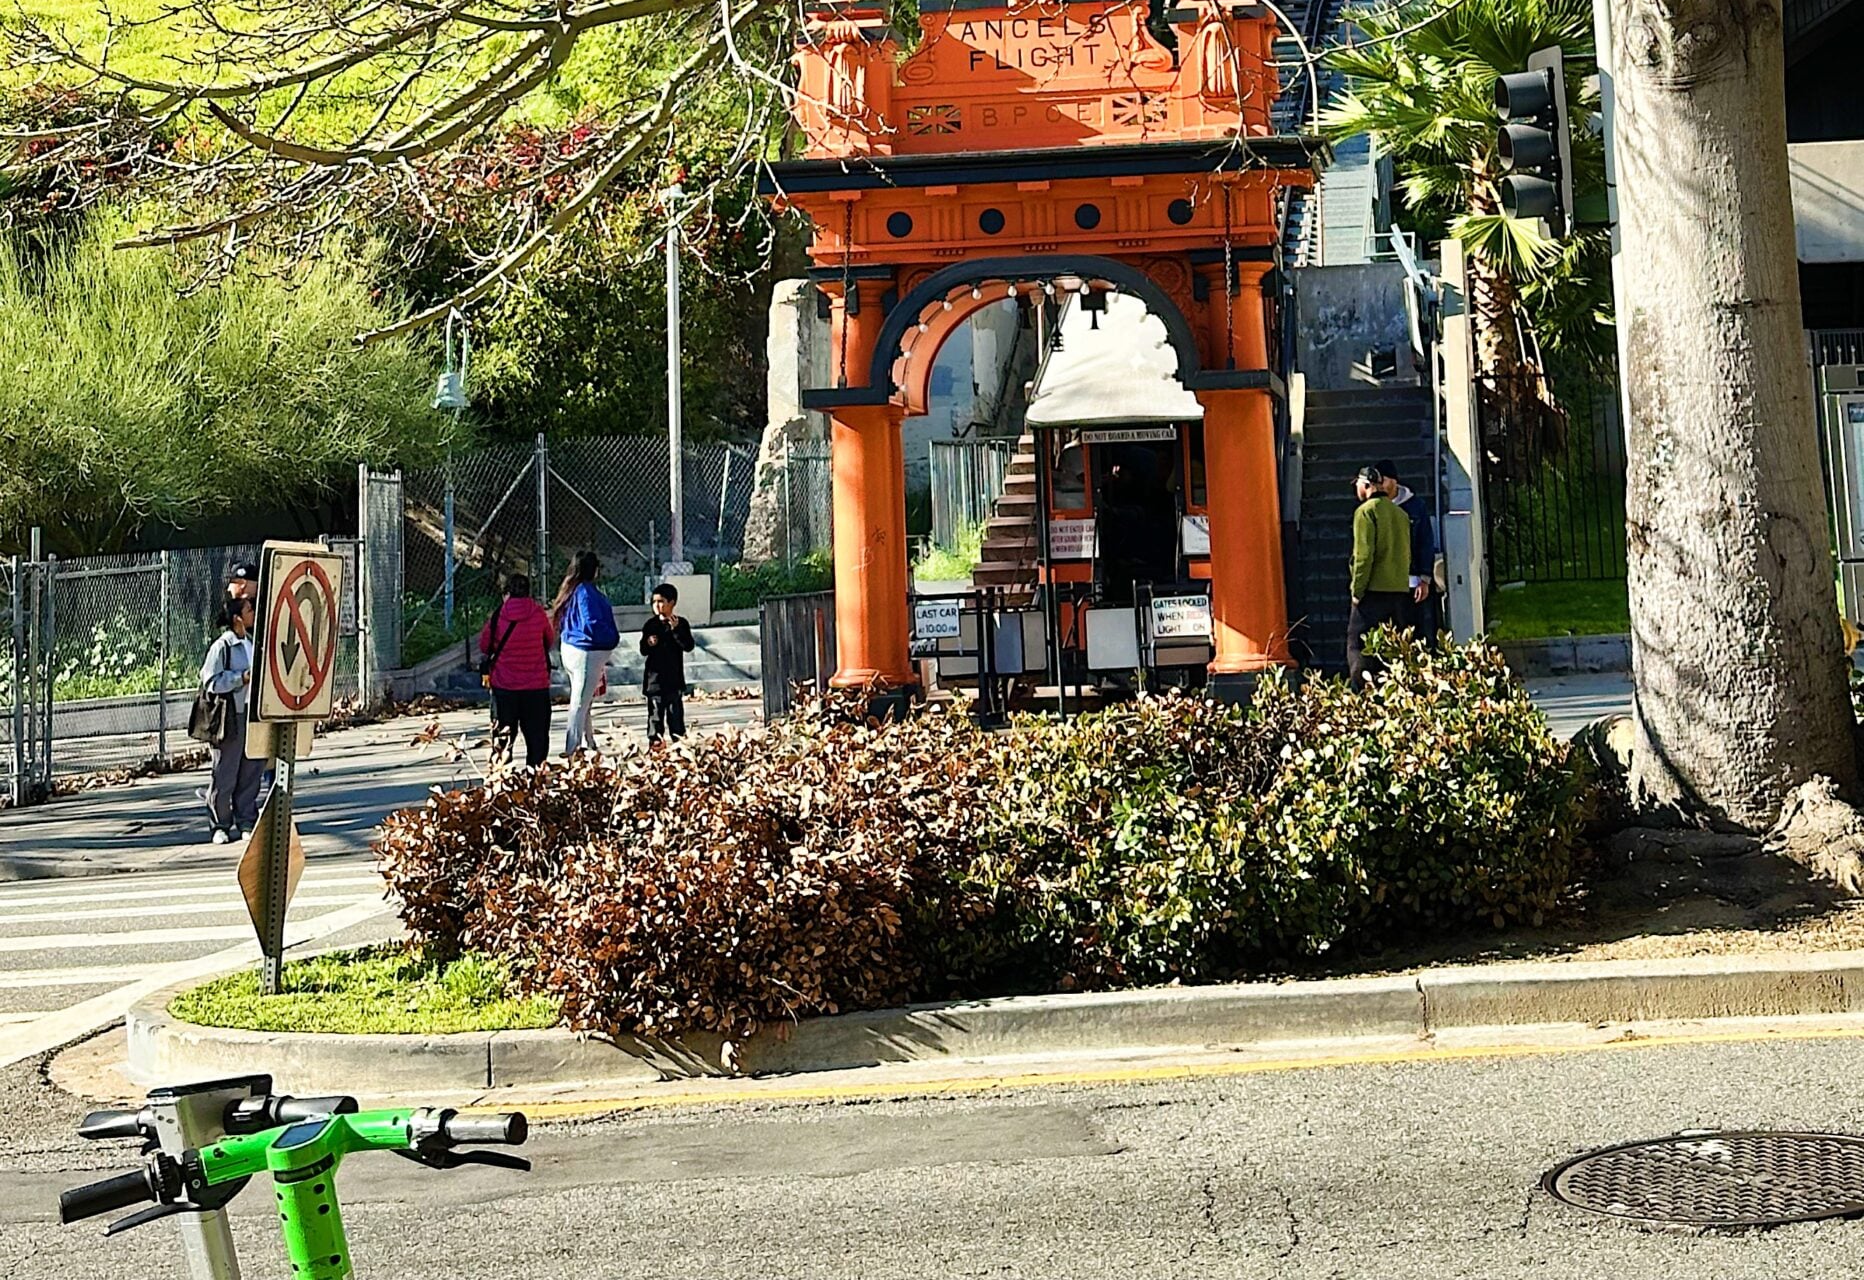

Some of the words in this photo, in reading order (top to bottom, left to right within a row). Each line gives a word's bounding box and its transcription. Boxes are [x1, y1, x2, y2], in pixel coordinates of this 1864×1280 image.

[969, 44, 1101, 72] FLIGHT
[1083, 433, 1094, 441] DO
[1095, 432, 1107, 440] NOT
[1108, 431, 1130, 440] BOARD
[1137, 429, 1161, 439] MOVING
[1162, 429, 1174, 438] CAR
[1153, 597, 1177, 609] GATES
[916, 609, 937, 619] LAST
[939, 608, 957, 617] CAR
[1157, 611, 1184, 621] WHEN
[1192, 624, 1206, 632] ON
